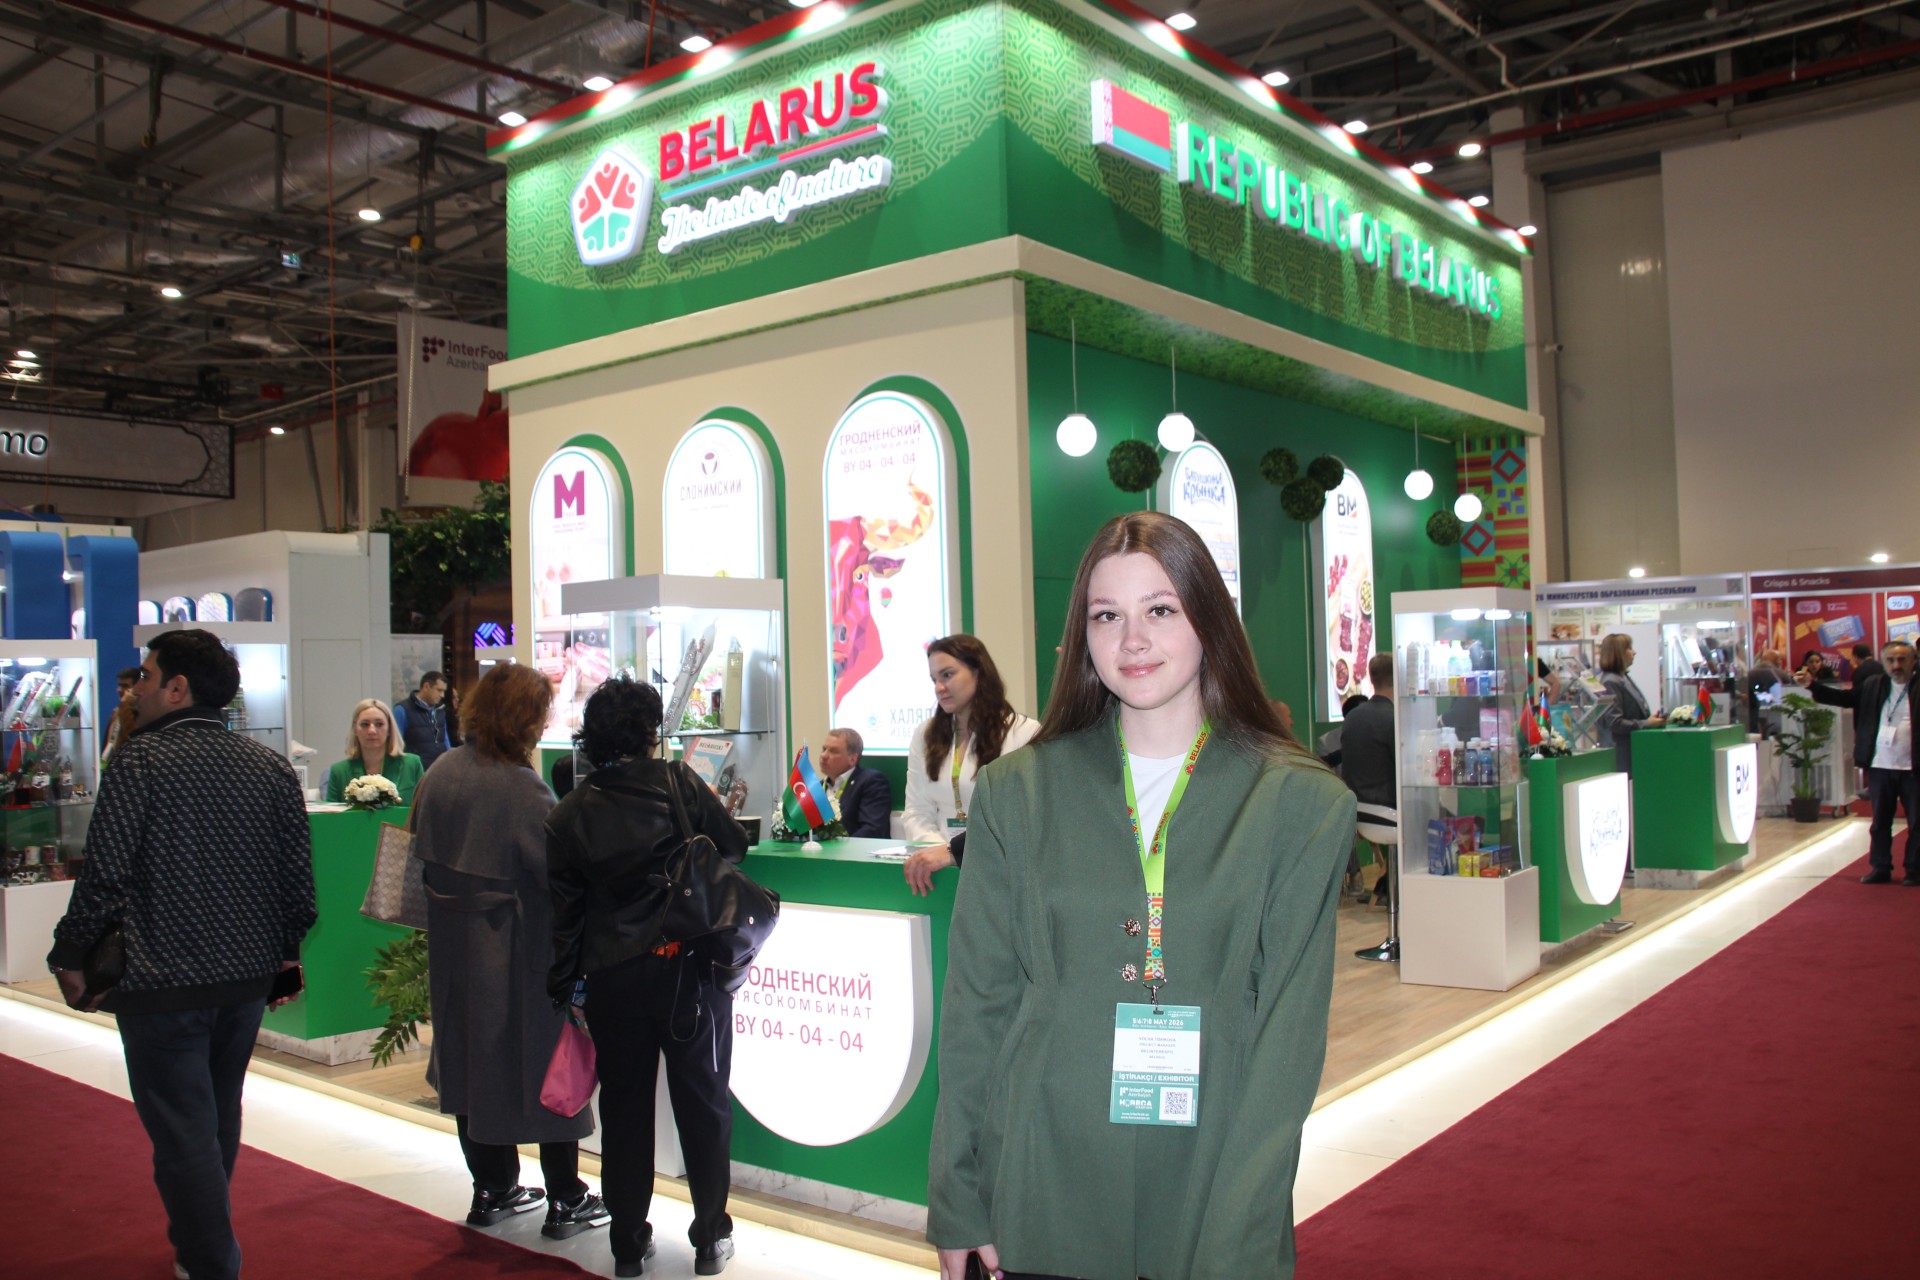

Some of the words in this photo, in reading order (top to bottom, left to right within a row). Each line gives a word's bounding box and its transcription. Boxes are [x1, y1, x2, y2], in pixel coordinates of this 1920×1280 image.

[659, 62, 882, 181] BELARUS
[660, 207, 698, 249] The
[704, 190, 758, 229] taste
[766, 173, 792, 217] of
[798, 157, 880, 201] nature
[1181, 122, 1351, 251] REPUBLIC
[1352, 212, 1391, 268] OF
[1395, 232, 1501, 319] BELARUS
[840, 419, 921, 446] ГРОДНЕНСКИЙ
[859, 459, 872, 471] 04
[881, 456, 893, 468] 04
[903, 452, 916, 464] 04
[1547, 590, 1598, 601] МИНИСТЕРСТВО
[1600, 588, 1649, 598] ОБРАЗОВАНИЯ
[1651, 586, 1697, 596] РЕСПУБЛИКИ
[1763, 578, 1789, 589] Crisps
[1791, 578, 1798, 586] &
[1799, 577, 1830, 586] Snacks
[1189, 731, 1207, 761] BELARUS
[747, 965, 872, 1000] ОДНЕНСКИЙ
[762, 1018, 783, 1040] 04
[800, 1024, 822, 1047] 04
[840, 1030, 863, 1053] 04
[1168, 1018, 1184, 1026] 2026
[1157, 1075, 1195, 1083] EXHIBITOR
